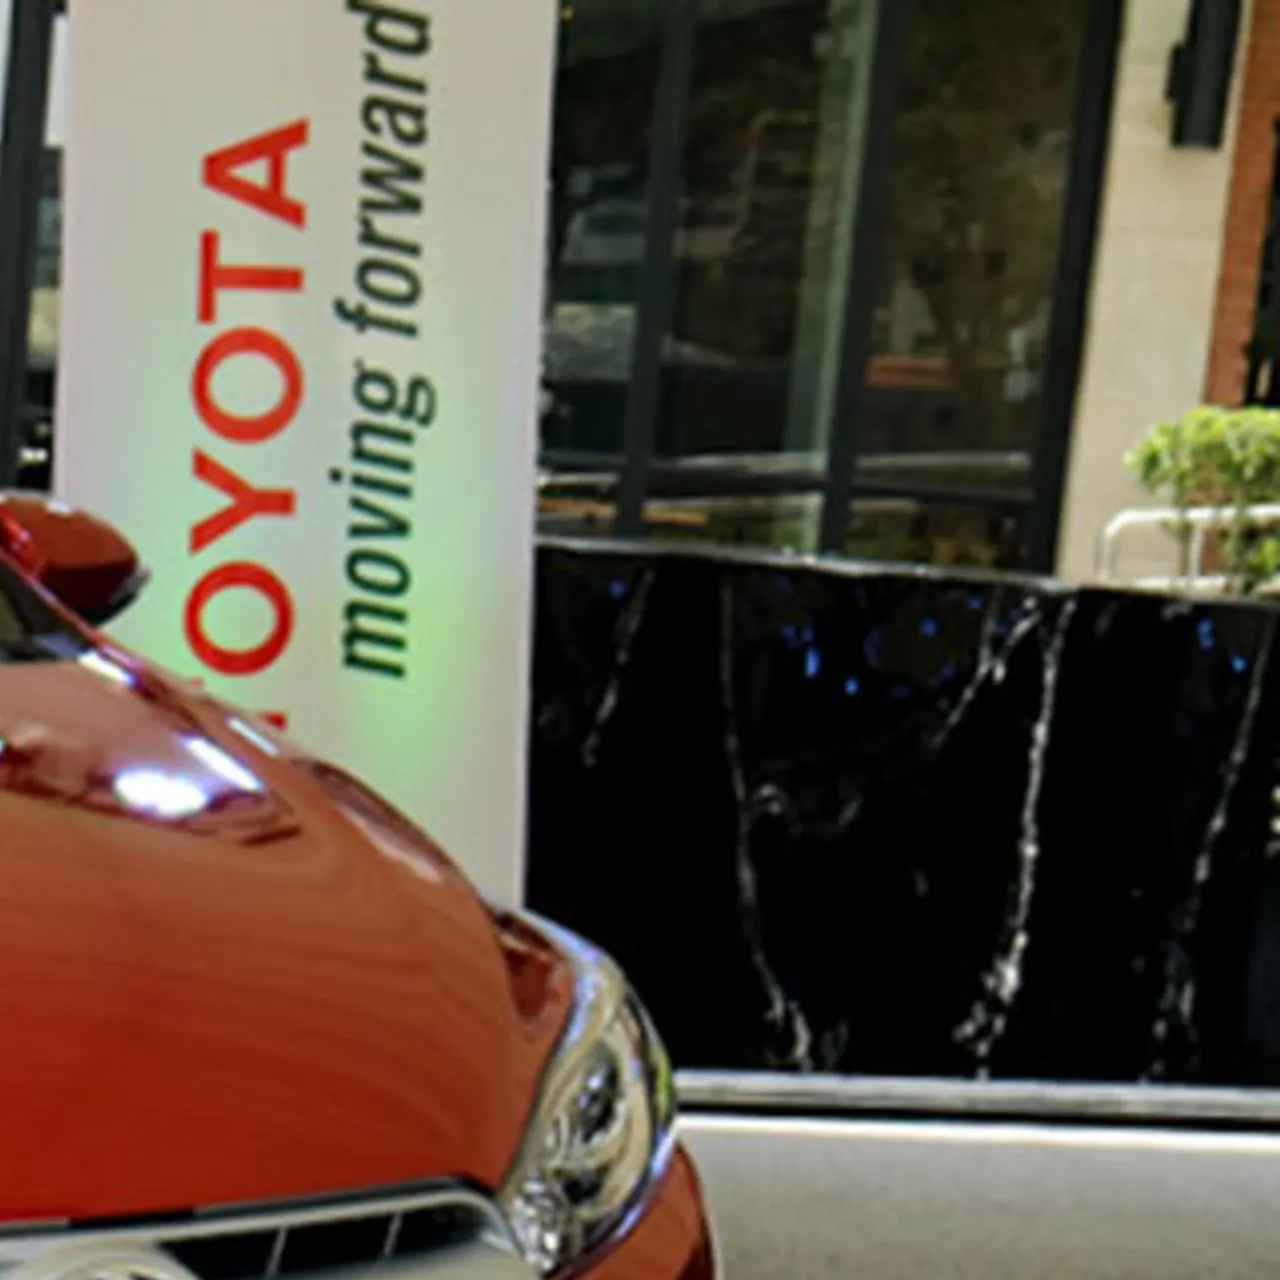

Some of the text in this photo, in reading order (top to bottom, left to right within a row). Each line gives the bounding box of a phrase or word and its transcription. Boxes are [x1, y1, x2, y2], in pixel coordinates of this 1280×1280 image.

[183, 119, 311, 731] OYOTA
[328, 0, 436, 679] moving forward
